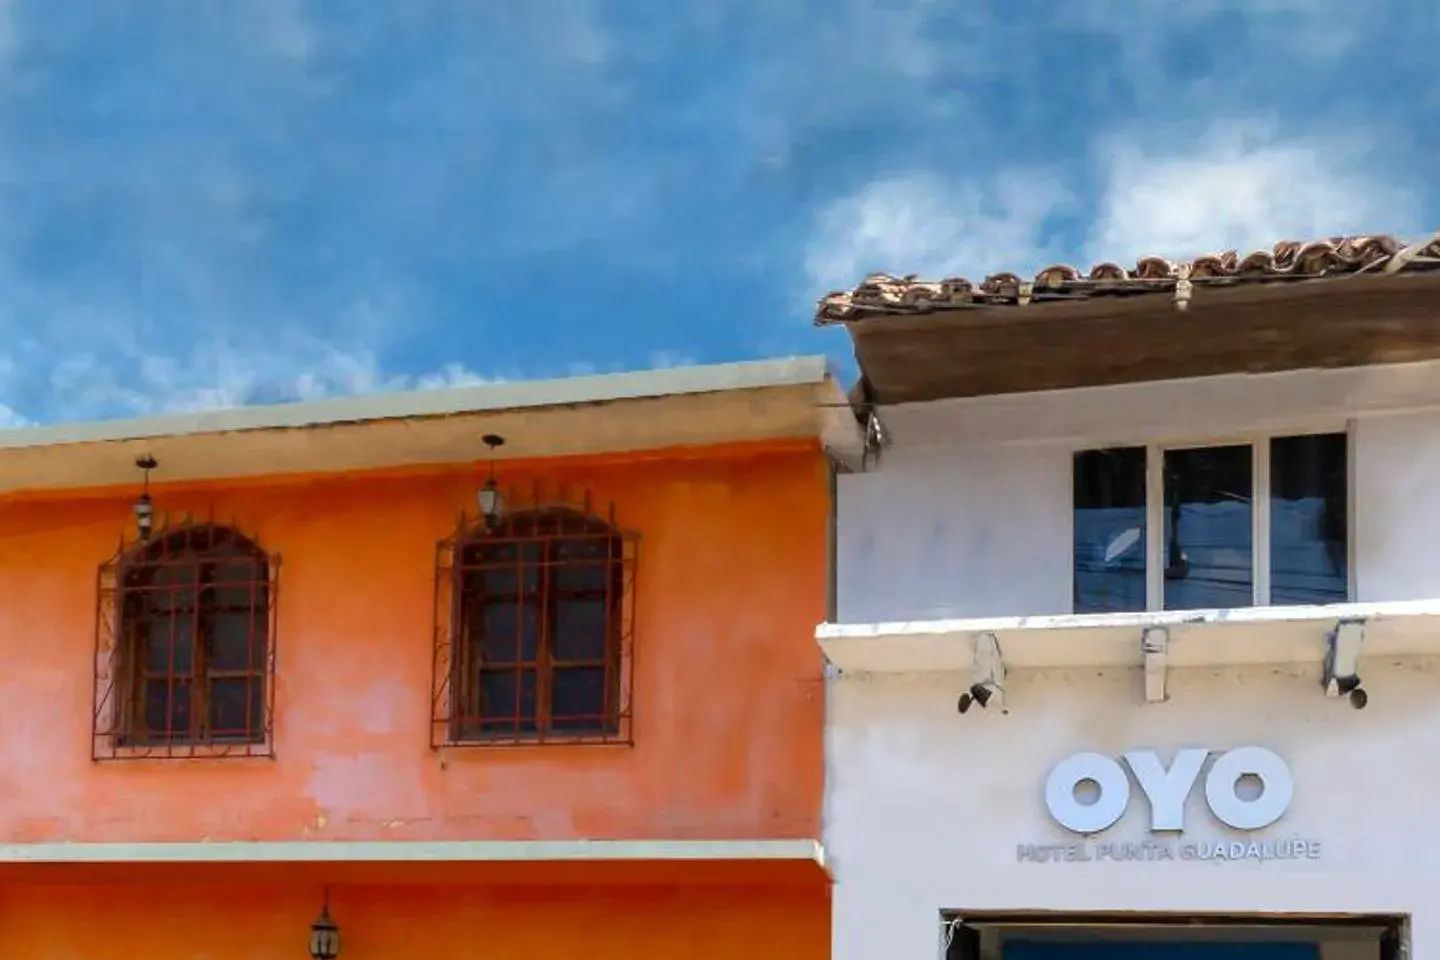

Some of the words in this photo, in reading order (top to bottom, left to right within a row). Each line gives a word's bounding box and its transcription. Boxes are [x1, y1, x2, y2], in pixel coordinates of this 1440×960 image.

[1046, 746, 1294, 833] OYO
[1016, 843, 1092, 863] HOTEL
[1098, 842, 1171, 862] PUNTA
[1179, 840, 1321, 862] GUADALUPE
